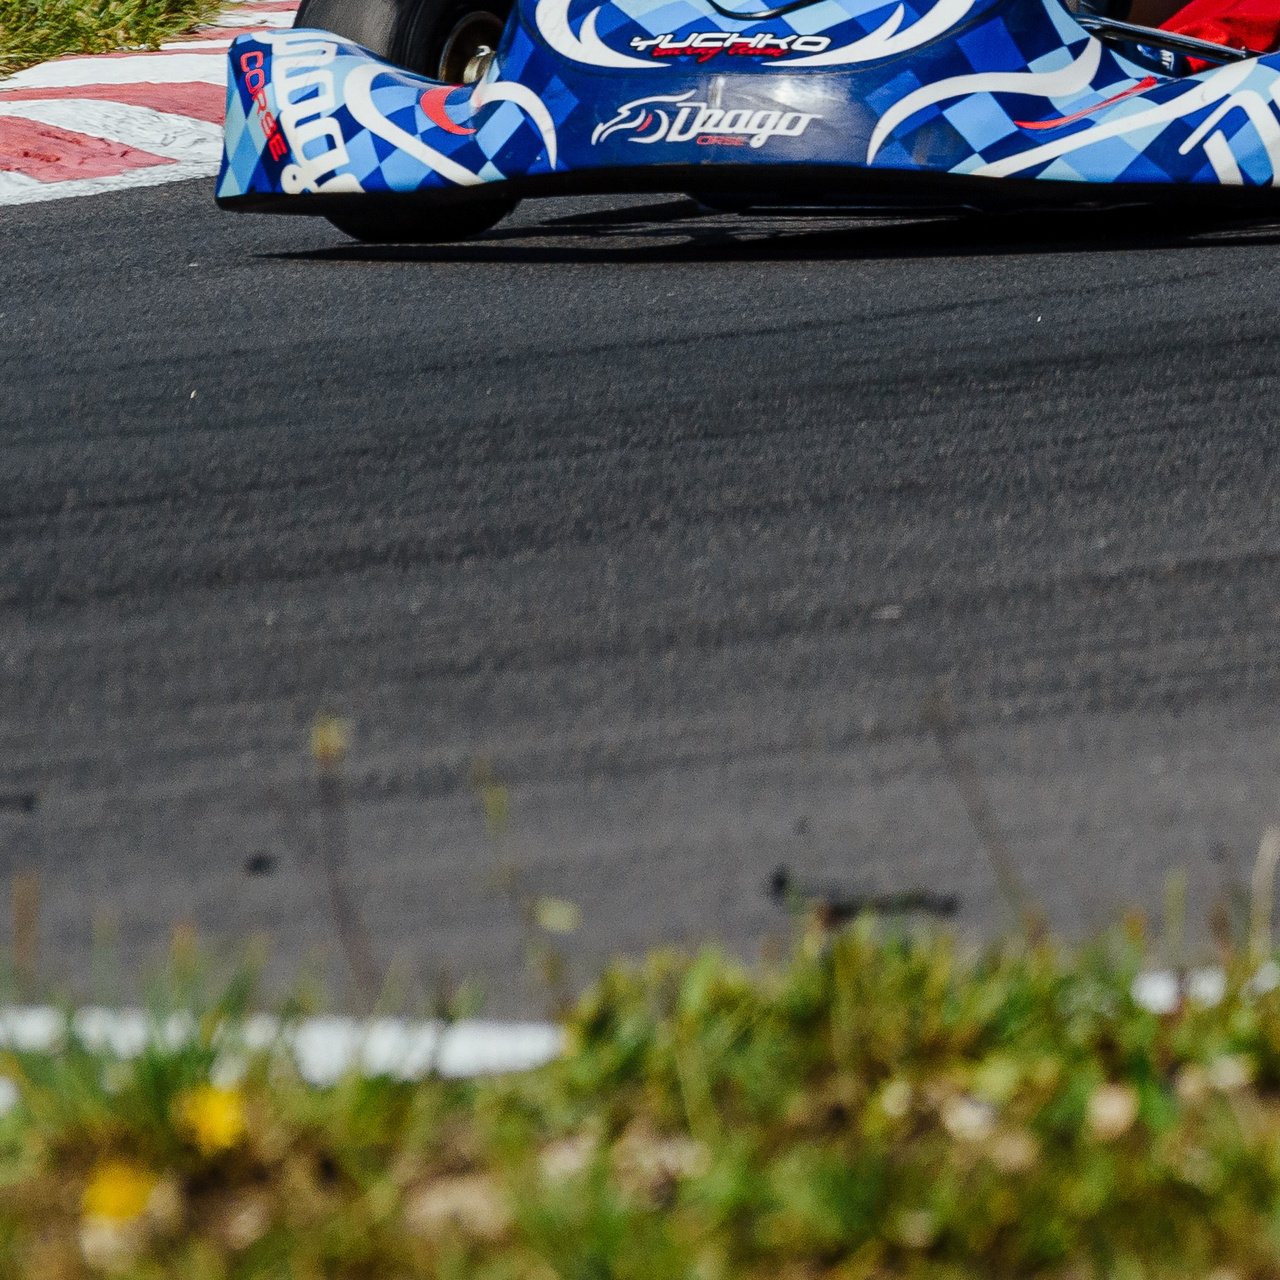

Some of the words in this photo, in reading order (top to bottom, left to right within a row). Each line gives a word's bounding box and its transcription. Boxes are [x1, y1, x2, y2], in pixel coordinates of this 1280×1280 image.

[630, 33, 832, 52] YUCHKO
[240, 51, 288, 162] CORSE
[665, 102, 823, 149] Drago
